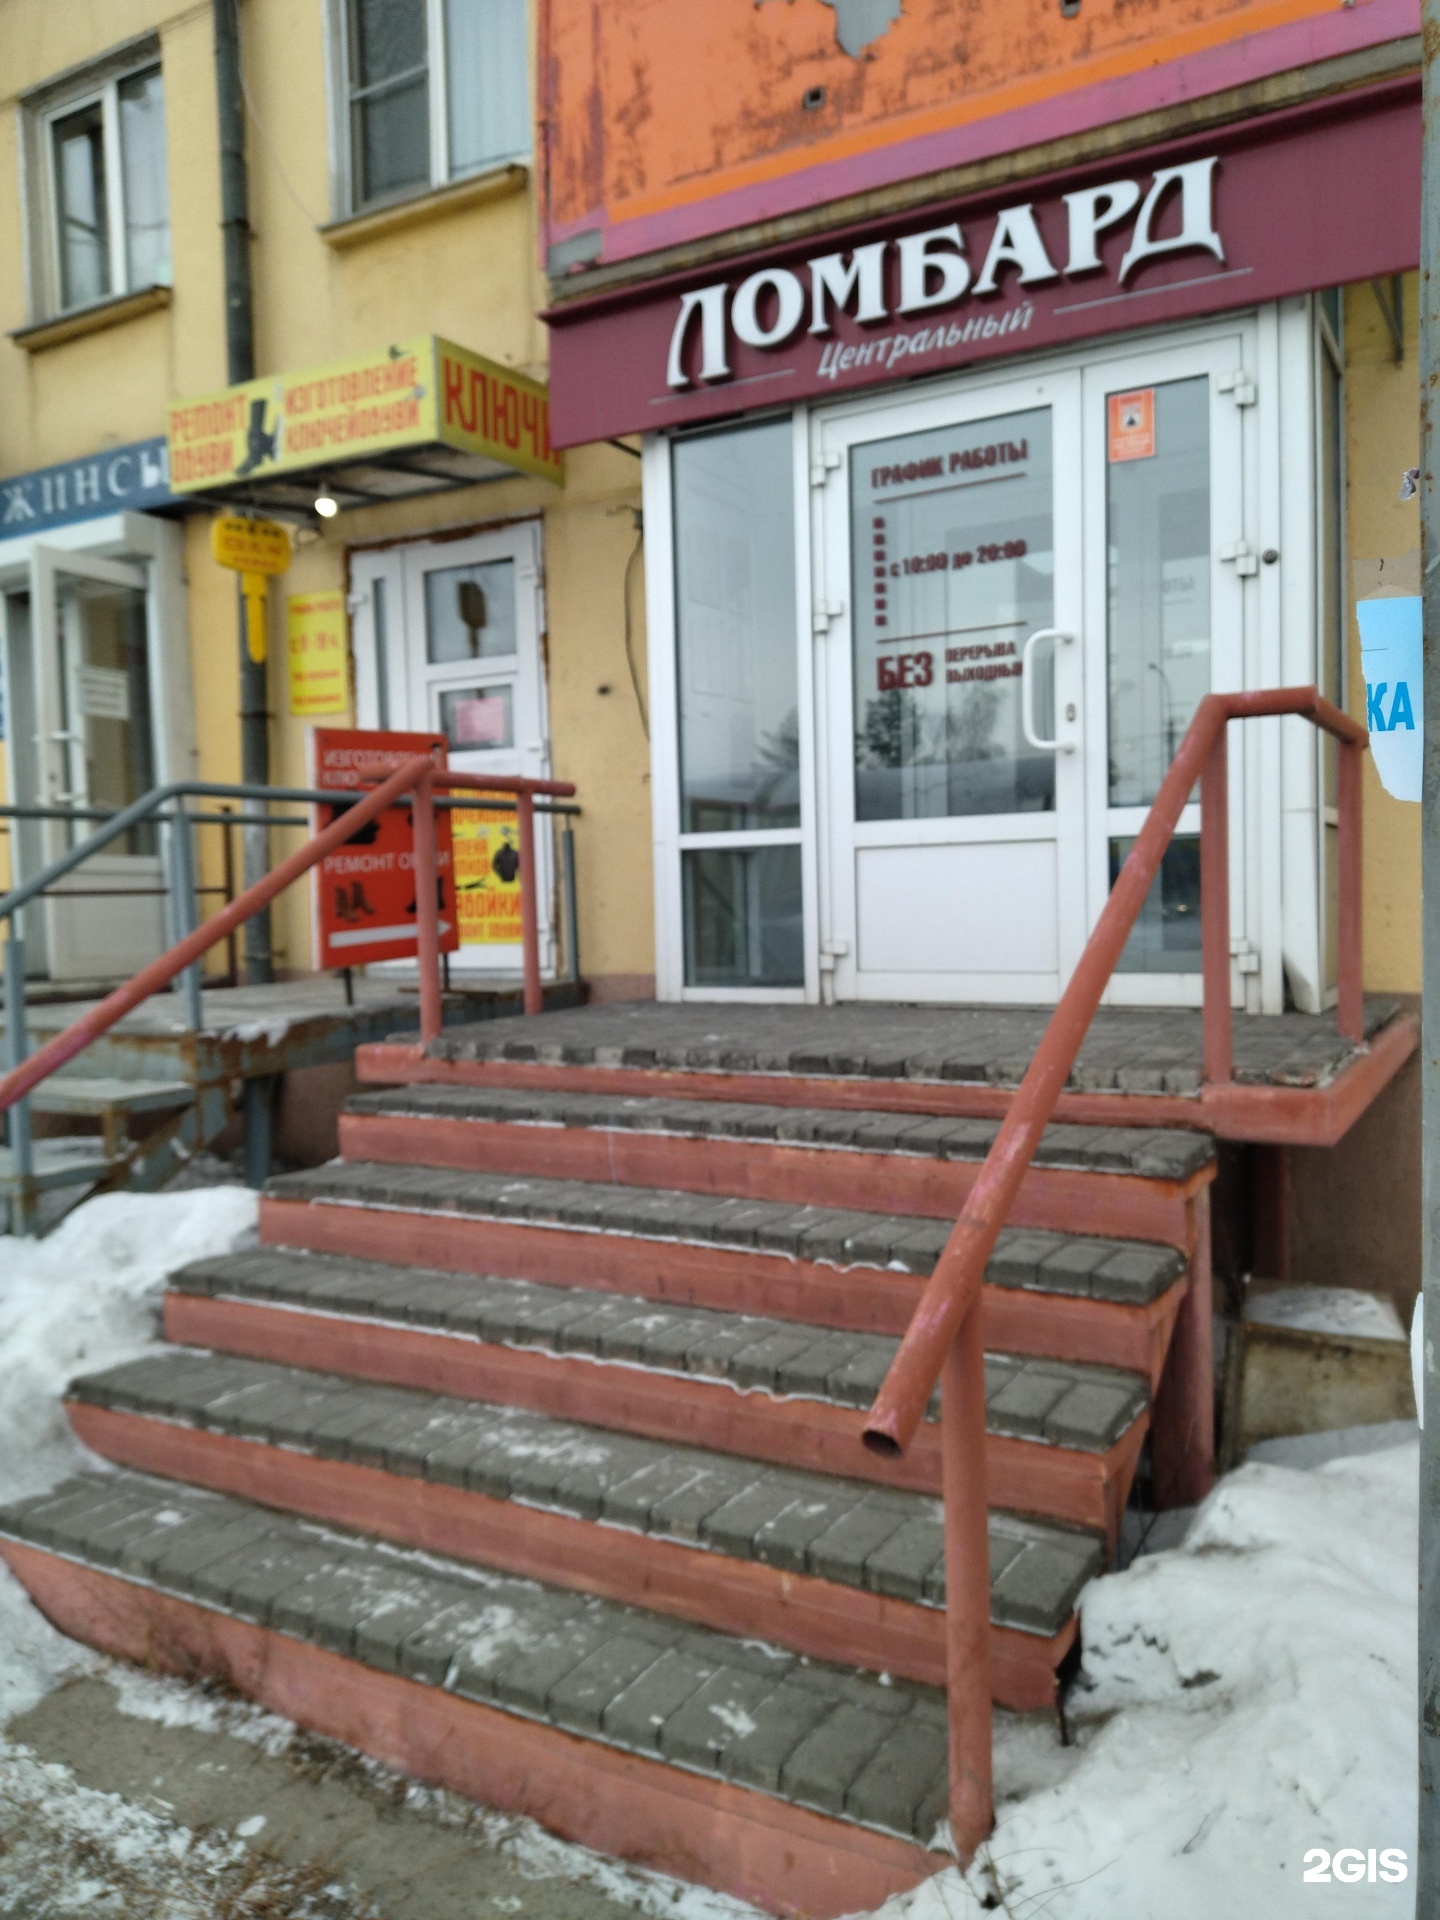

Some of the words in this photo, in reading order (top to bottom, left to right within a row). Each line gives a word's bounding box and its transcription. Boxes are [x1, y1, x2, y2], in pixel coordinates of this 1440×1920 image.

[666, 155, 1225, 389] ЛОМБАРД
[816, 300, 1036, 382] Центральный
[871, 456, 945, 489] ГРАФИК
[949, 438, 1029, 474] РАБОТЫ
[902, 552, 948, 576] 10:00
[952, 550, 974, 571] до
[976, 539, 1028, 564] 20:00
[876, 651, 935, 692] БЕЗ
[945, 641, 1016, 663] ПЕРЕРЫВА
[1366, 681, 1416, 732] КА
[322, 852, 395, 875] РЕМОНТ
